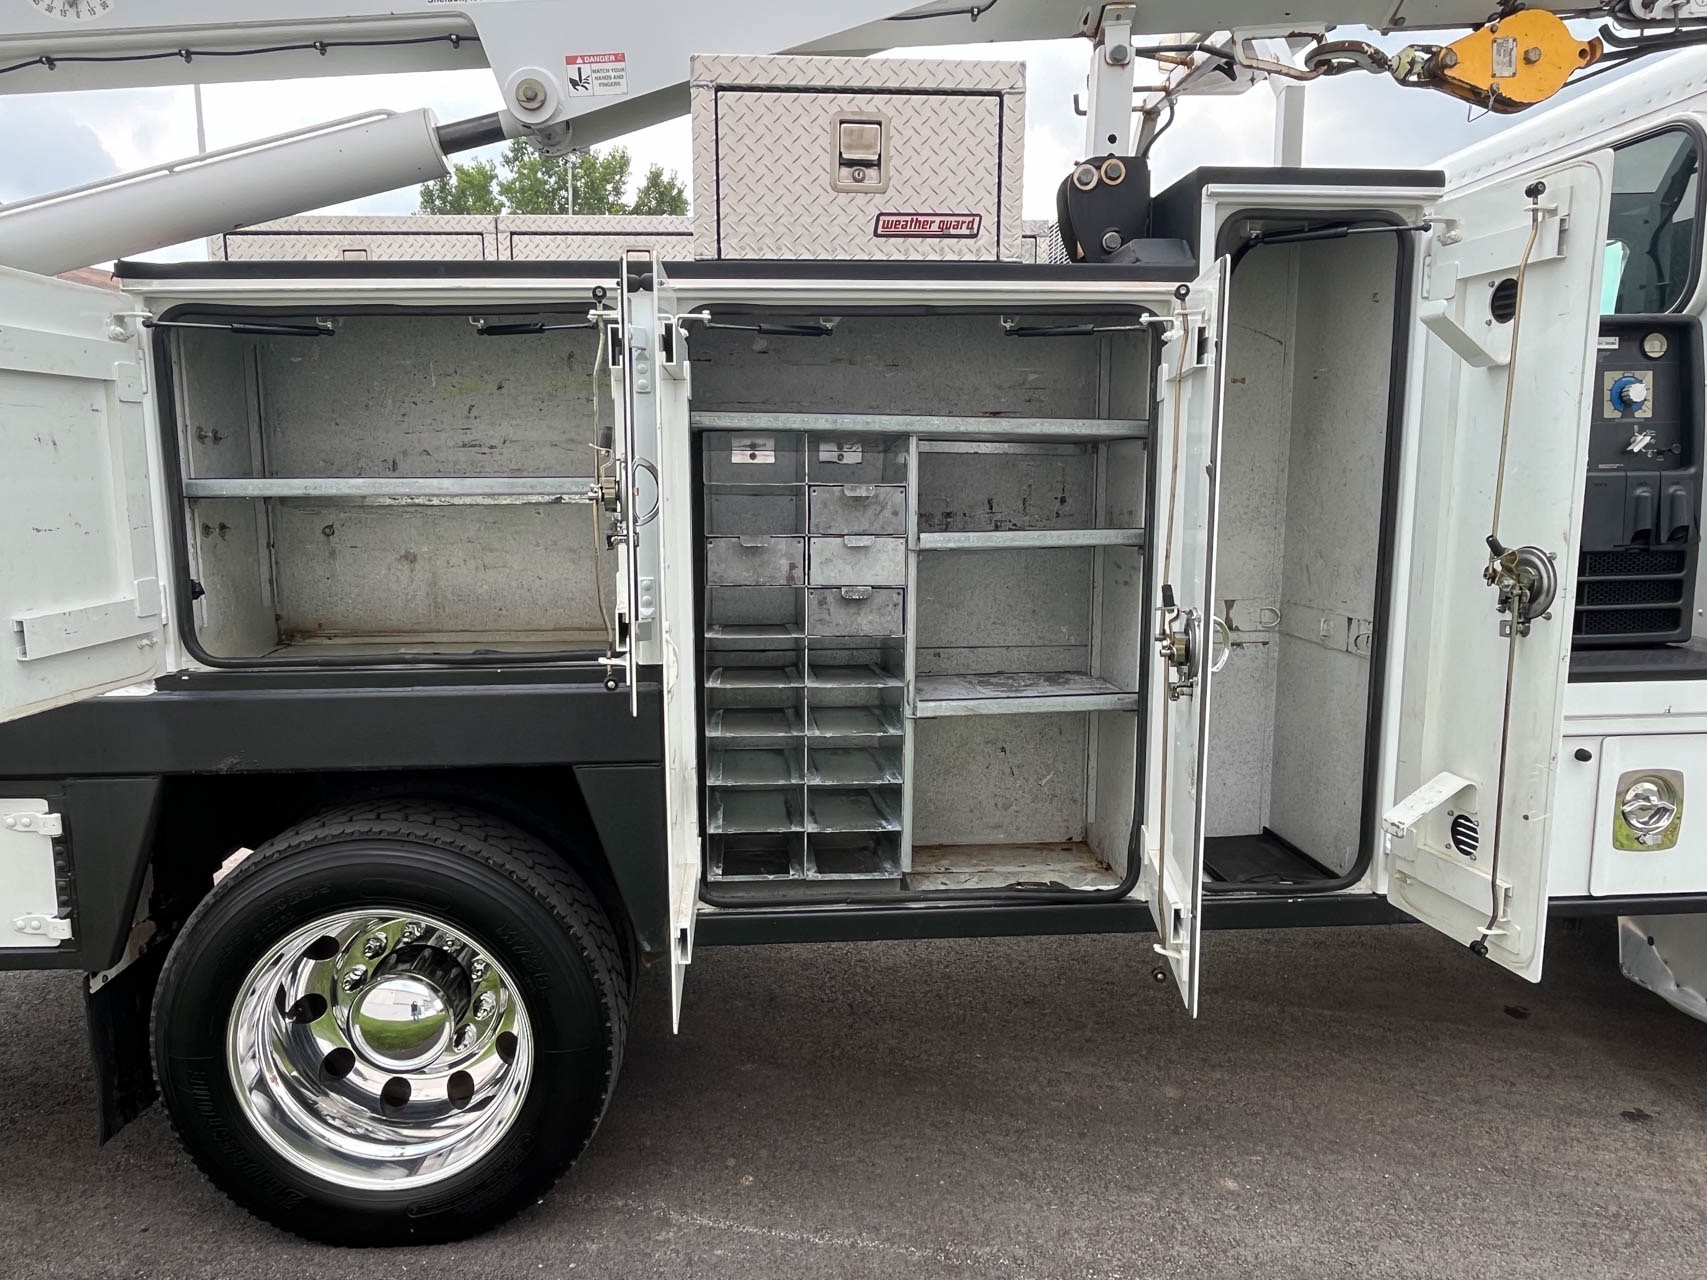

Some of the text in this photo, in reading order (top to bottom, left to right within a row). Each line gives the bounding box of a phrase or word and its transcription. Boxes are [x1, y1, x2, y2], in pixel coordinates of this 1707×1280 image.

[584, 55, 615, 63] DANGER
[881, 217, 975, 232] weather guard
